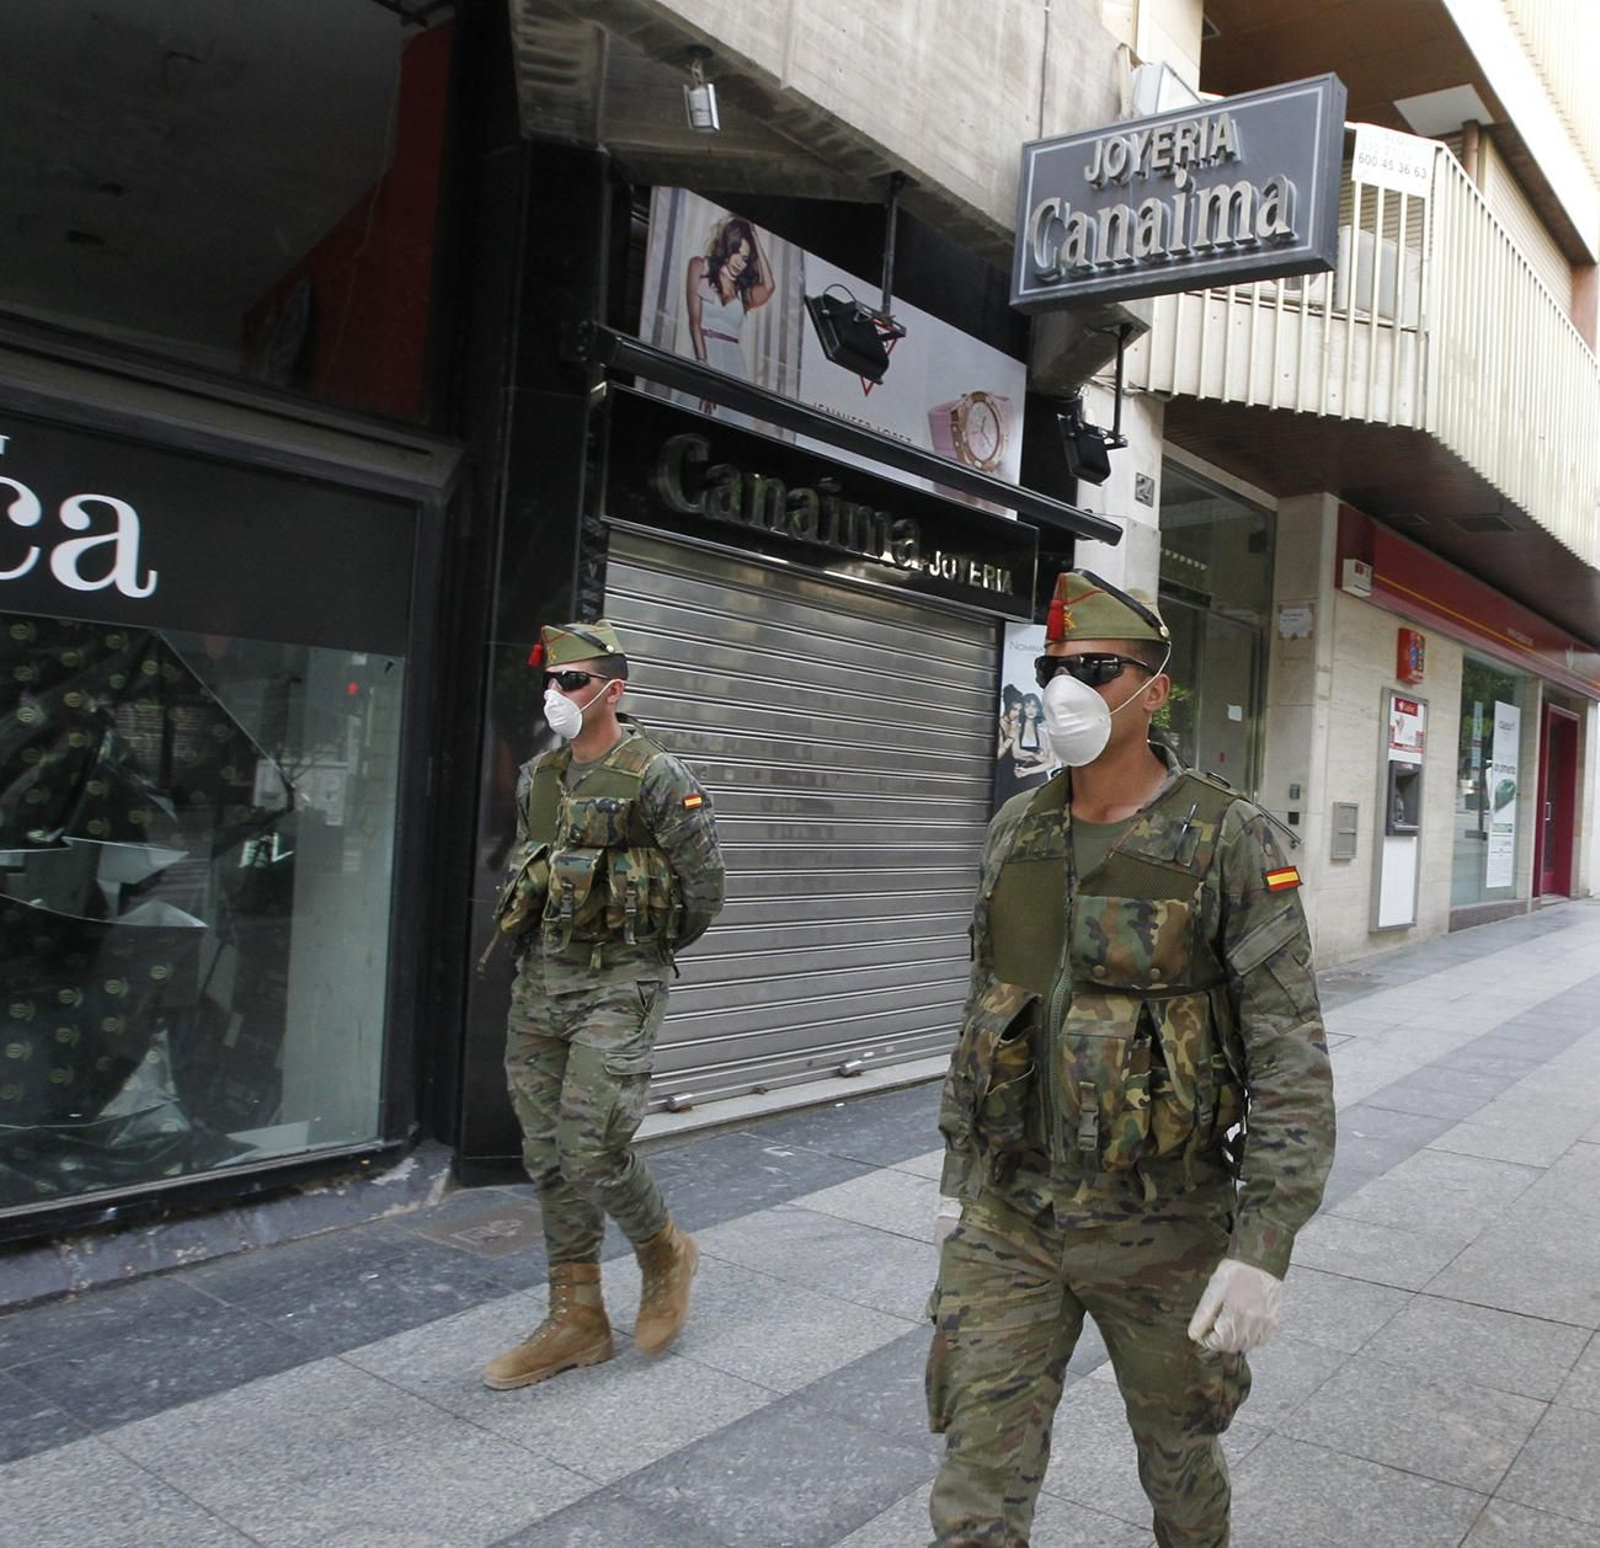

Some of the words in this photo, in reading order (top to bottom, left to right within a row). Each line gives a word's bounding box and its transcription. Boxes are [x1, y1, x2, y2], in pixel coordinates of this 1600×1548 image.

[1083, 113, 1238, 189] JOYERIA
[1358, 152, 1378, 167] 600
[1029, 168, 1298, 282] Canaima
[657, 433, 922, 569] Canaima
